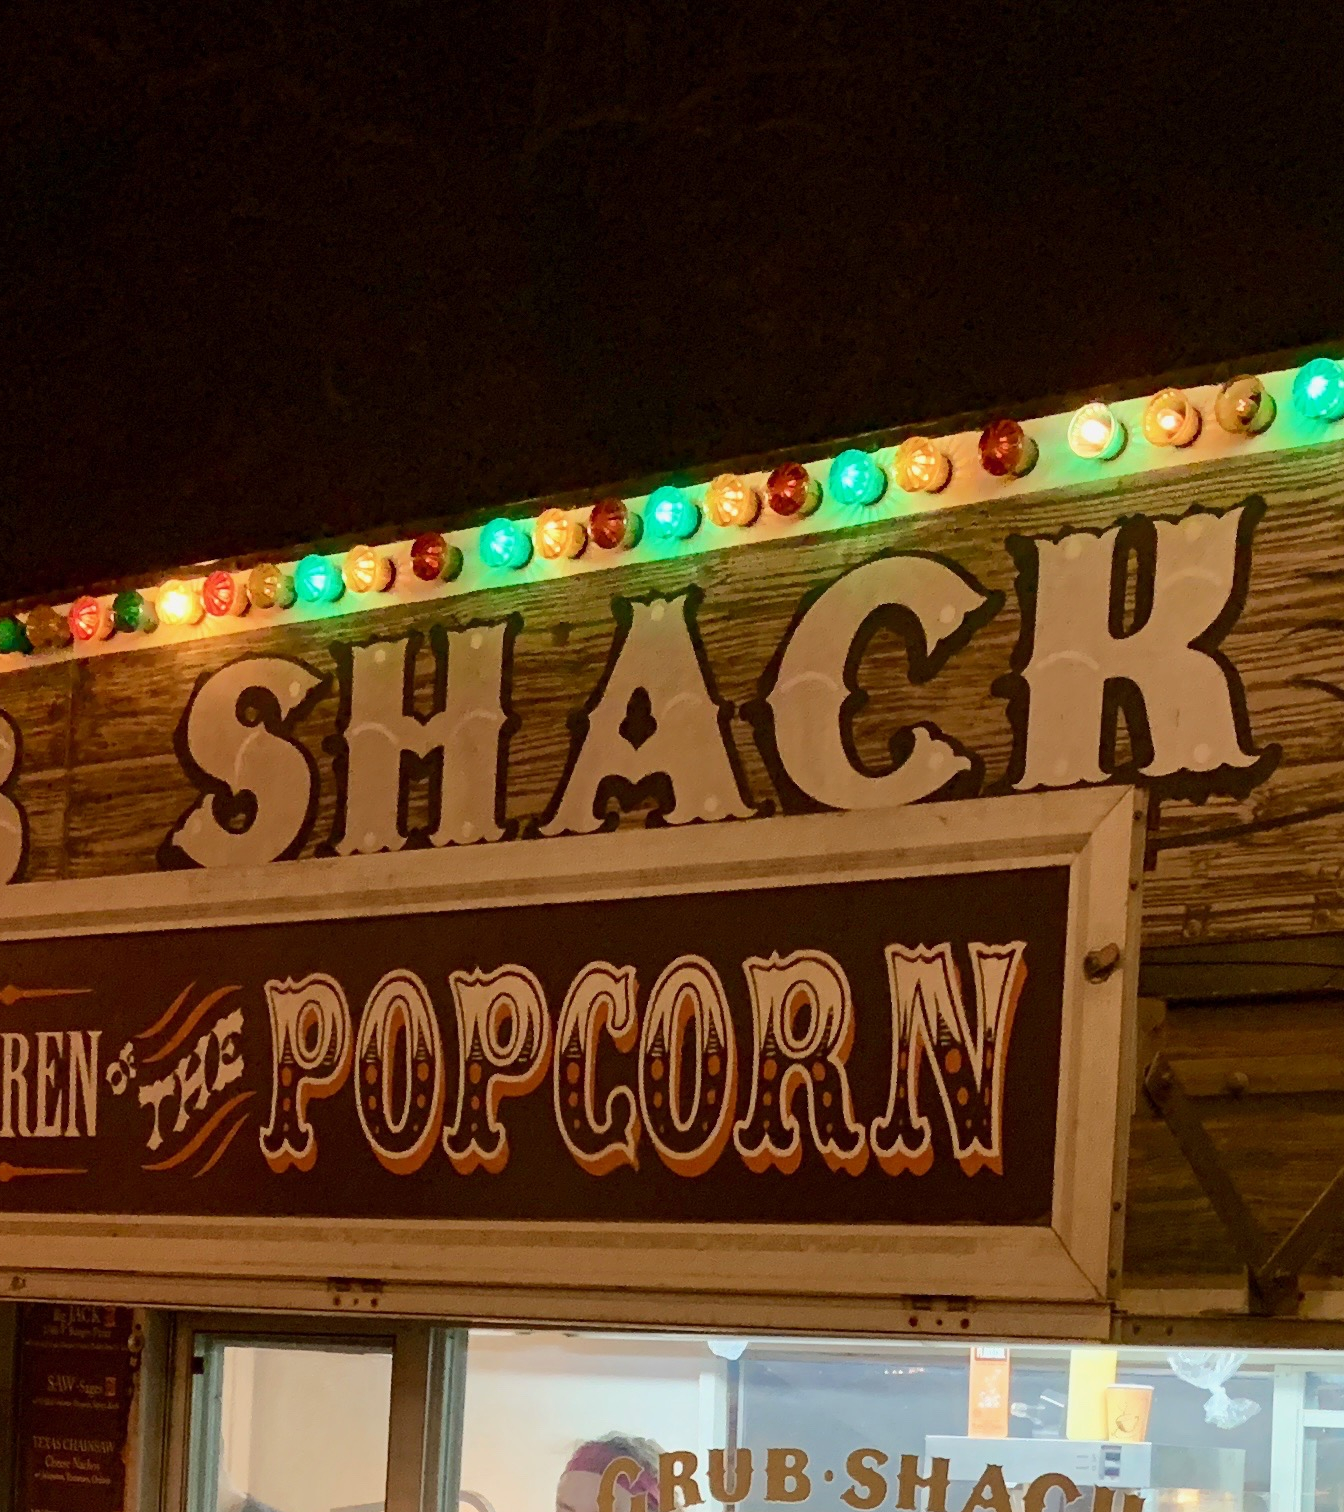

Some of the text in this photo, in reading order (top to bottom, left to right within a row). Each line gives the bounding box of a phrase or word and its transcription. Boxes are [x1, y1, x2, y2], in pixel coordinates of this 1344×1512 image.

[169, 496, 1278, 865] SHACK
[105, 1040, 137, 1096] OF
[137, 1007, 245, 1150] THE
[260, 940, 1026, 1174] POPCORN
